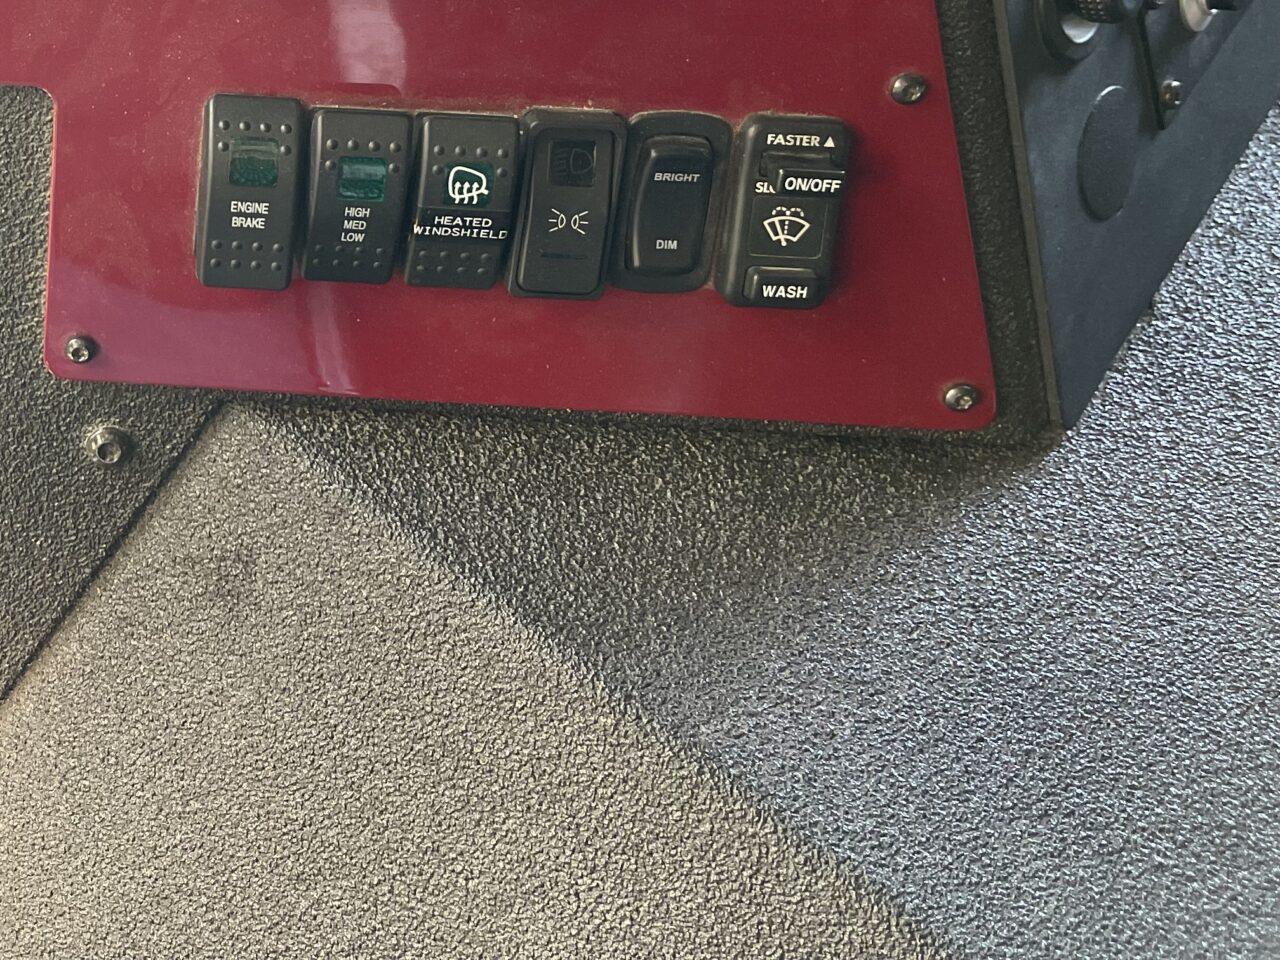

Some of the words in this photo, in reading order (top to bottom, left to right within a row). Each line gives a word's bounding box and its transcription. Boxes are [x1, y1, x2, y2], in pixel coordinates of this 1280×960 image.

[766, 133, 821, 147] FASTER
[653, 171, 700, 183] BRIGHT
[784, 176, 842, 193] ON/OFF
[230, 200, 270, 215] ENGINE
[344, 206, 371, 218] HIGH
[231, 216, 266, 229] BRAKE
[343, 219, 367, 231] MED
[433, 215, 493, 228] HEATED
[341, 231, 365, 243] LOW
[413, 224, 508, 240] WINDSHIELD
[655, 239, 678, 251] DIM
[762, 284, 808, 299] WASH
